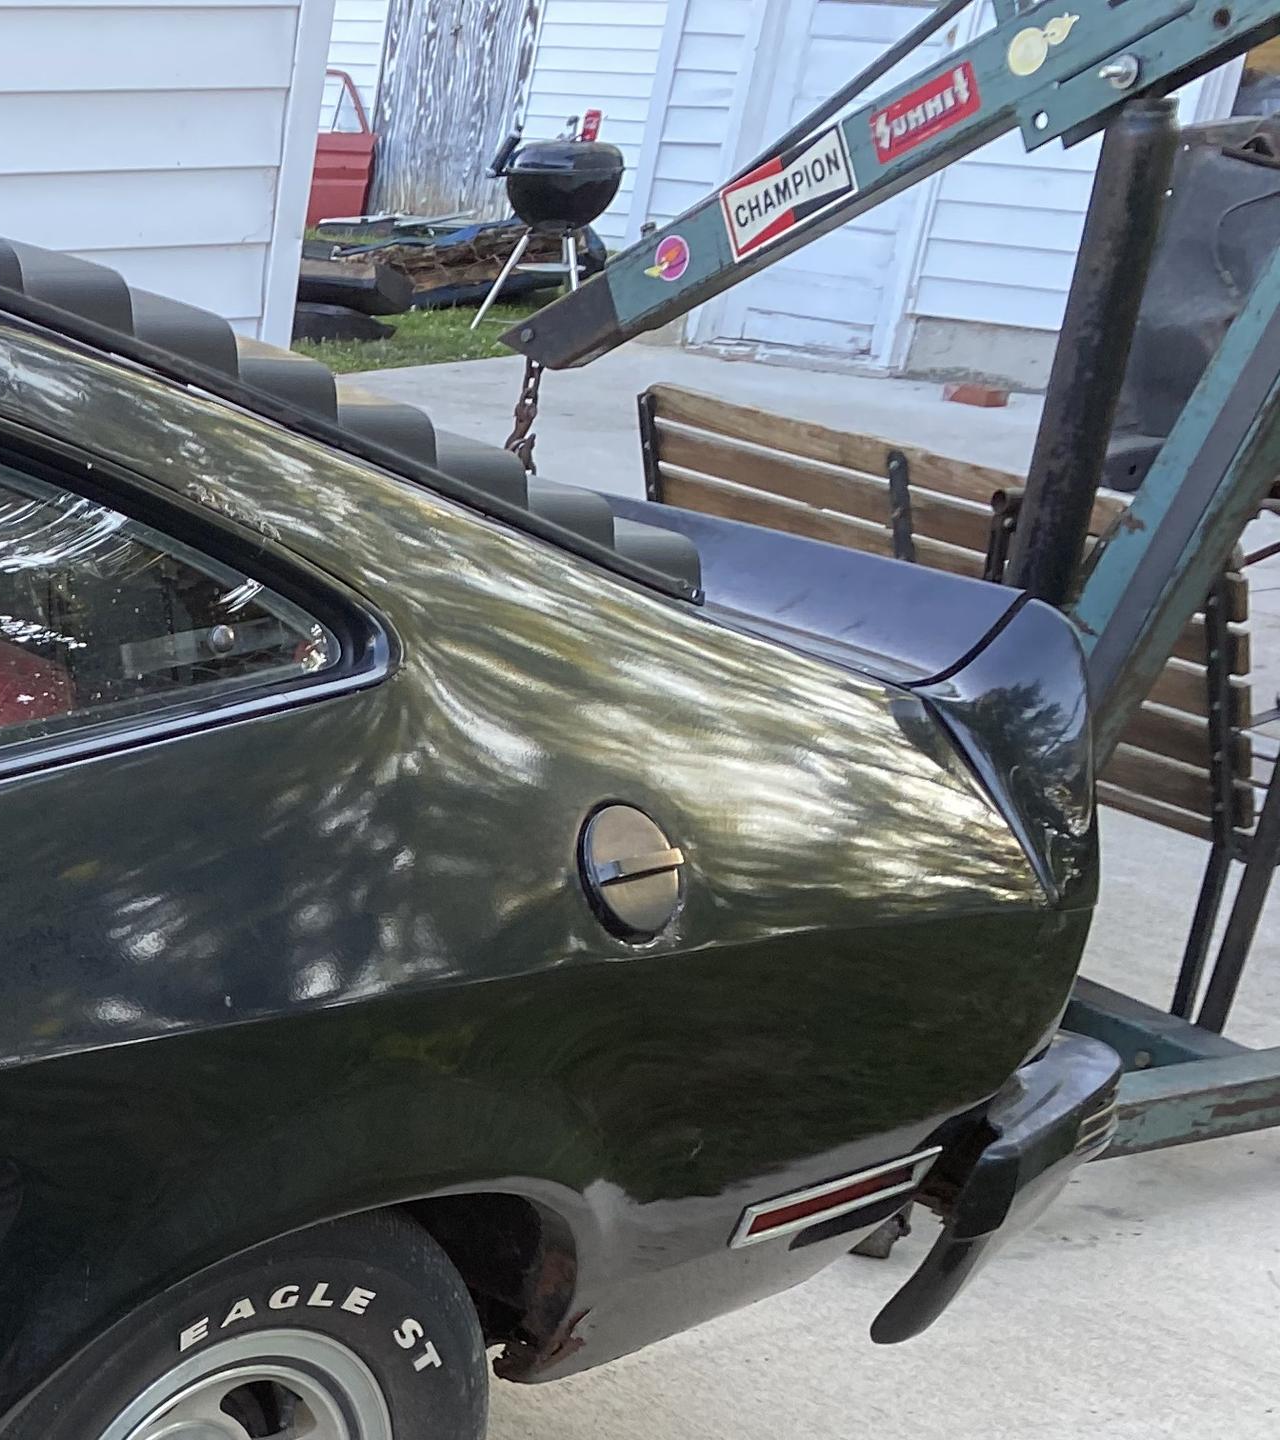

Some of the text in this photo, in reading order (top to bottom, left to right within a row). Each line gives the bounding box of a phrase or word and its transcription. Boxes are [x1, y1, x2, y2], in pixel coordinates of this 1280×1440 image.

[735, 148, 840, 228] CHAMPION
[179, 1282, 443, 1374] EAGLE ST
